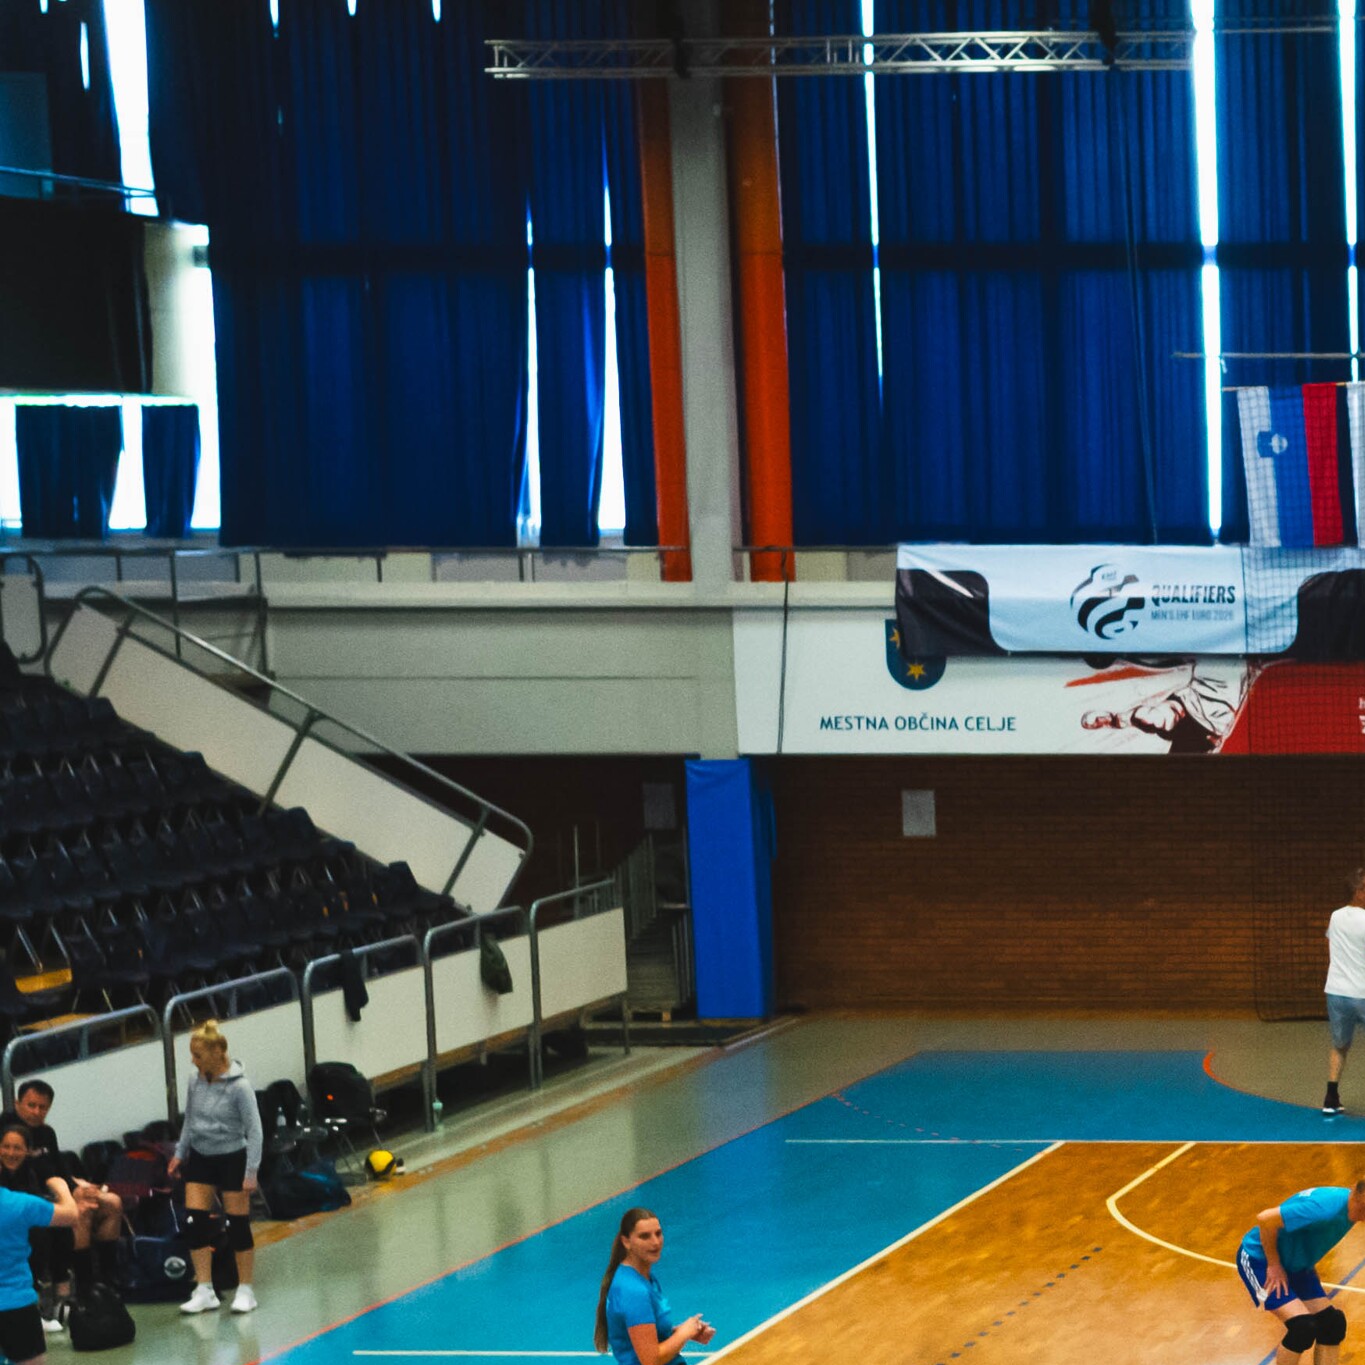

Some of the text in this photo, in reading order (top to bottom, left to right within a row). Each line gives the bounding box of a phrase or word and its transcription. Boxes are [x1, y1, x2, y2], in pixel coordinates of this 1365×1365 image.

[1151, 585, 1236, 607] QUALIFIERS
[819, 712, 1017, 731] MESTNA OBČINA CELJE
